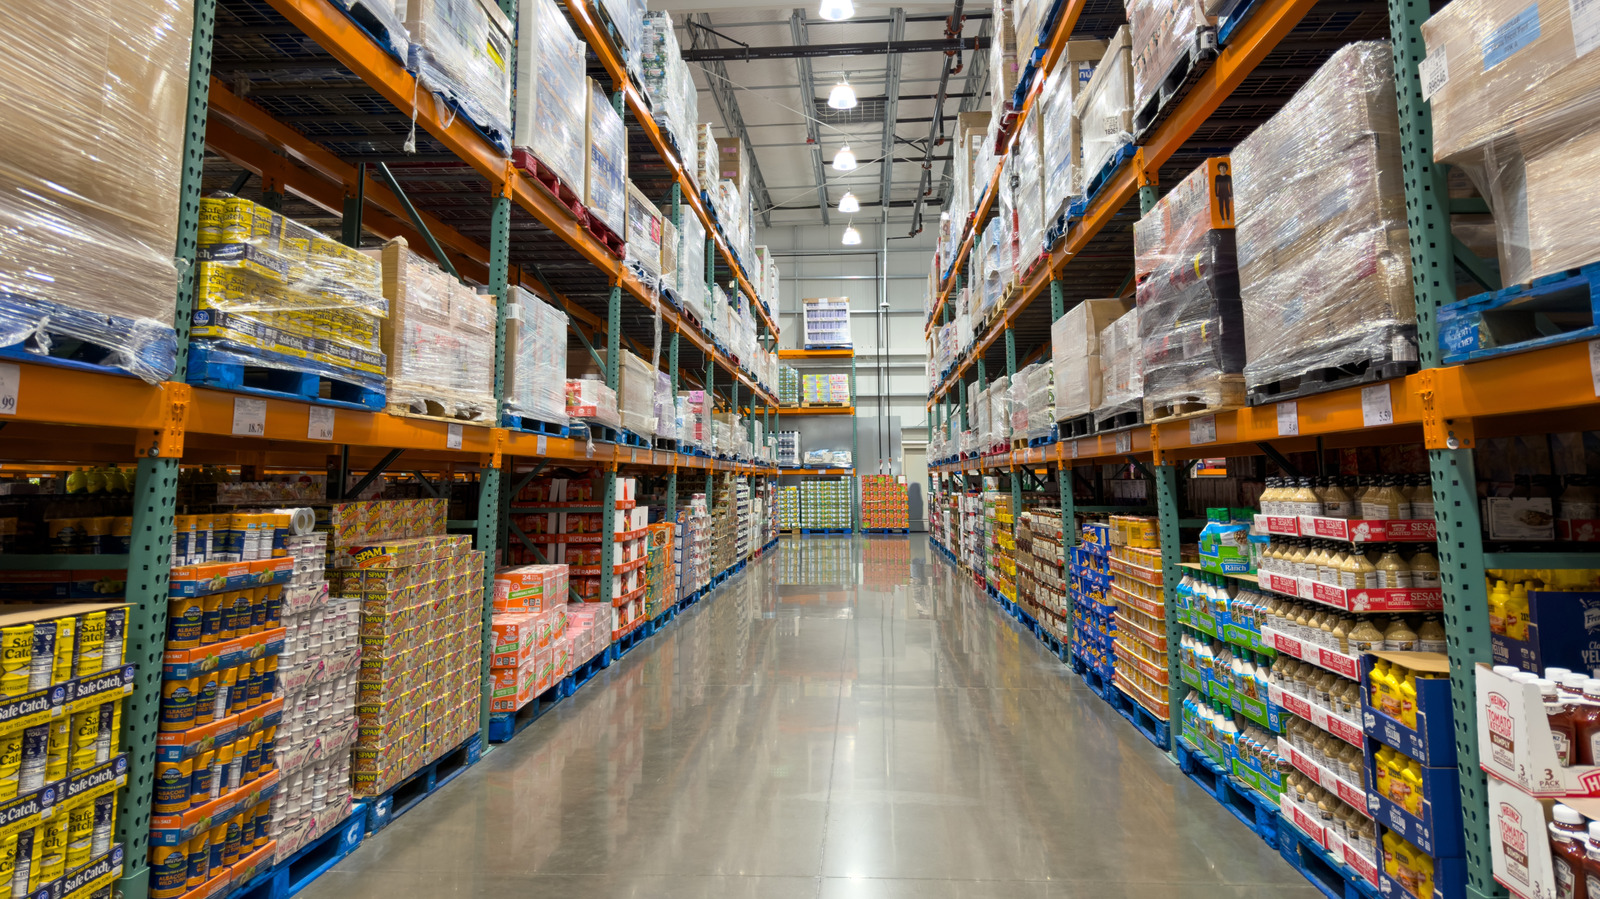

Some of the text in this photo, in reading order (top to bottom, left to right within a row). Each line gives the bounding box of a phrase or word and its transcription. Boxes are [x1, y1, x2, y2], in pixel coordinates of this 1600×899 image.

[1411, 523, 1436, 531] SESA
[356, 547, 383, 563] SPAM
[1411, 592, 1441, 601] SESAM
[1582, 651, 1600, 664] YEL
[77, 675, 122, 696] Safe Catch
[20, 697, 50, 713] Catch
[1490, 694, 1507, 711] HEINZ
[14, 717, 38, 728] YELLOWFIN
[38, 713, 50, 721] TUNA
[1269, 713, 1278, 723] 80
[1488, 709, 1512, 729] TOMATO
[1489, 722, 1512, 738] KETCHUP
[1493, 734, 1511, 750] SIMPLY
[1520, 764, 1526, 776] 3
[1544, 768, 1554, 780] 3
[68, 769, 114, 796] Safe Catch
[8, 801, 39, 821] Catch
[1502, 806, 1519, 824] HEINZ
[1500, 820, 1526, 843] TOMATO
[64, 861, 111, 893] Safe Catch
